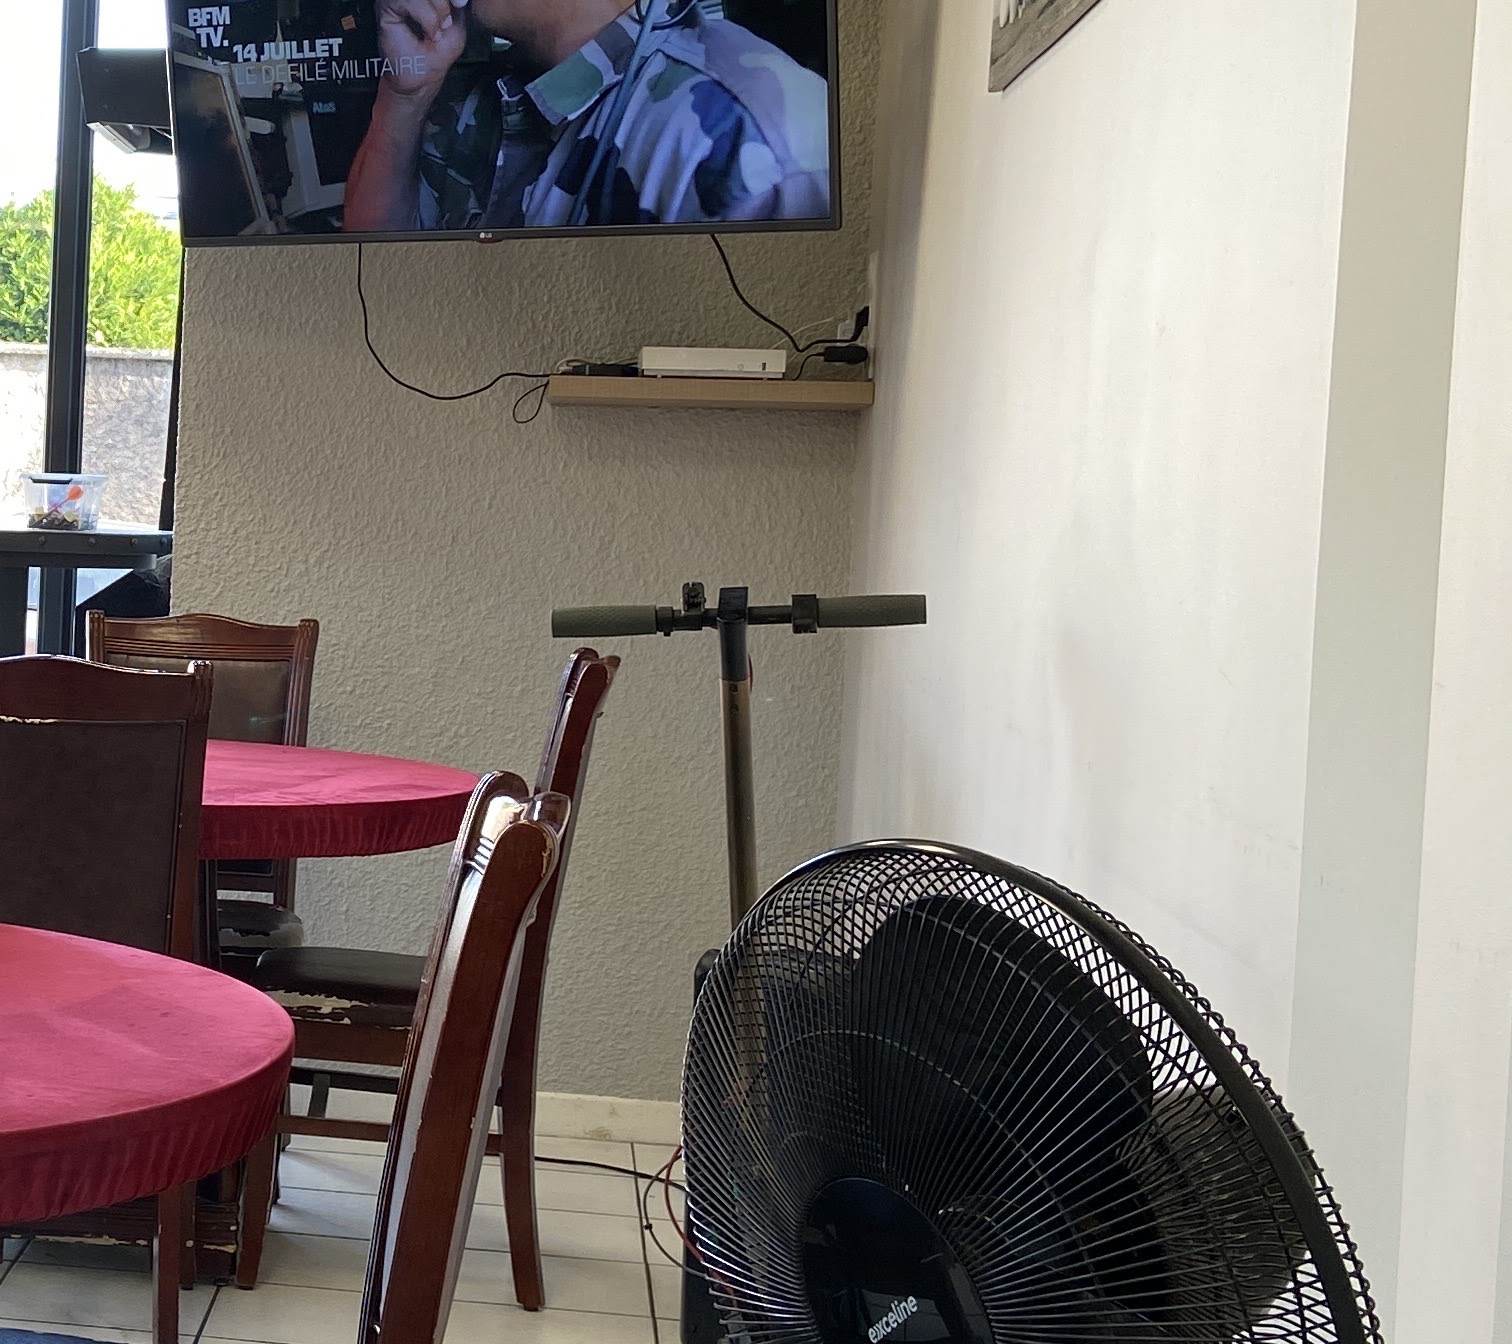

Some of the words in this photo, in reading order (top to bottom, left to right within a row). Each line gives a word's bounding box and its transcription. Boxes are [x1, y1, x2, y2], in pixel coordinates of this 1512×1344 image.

[188, 5, 231, 28] BFM
[233, 43, 258, 63] 14
[260, 37, 343, 61] JUILLET
[236, 64, 258, 85] LE
[332, 56, 427, 80] MILITAIRE
[868, 1295, 918, 1344] exceline
